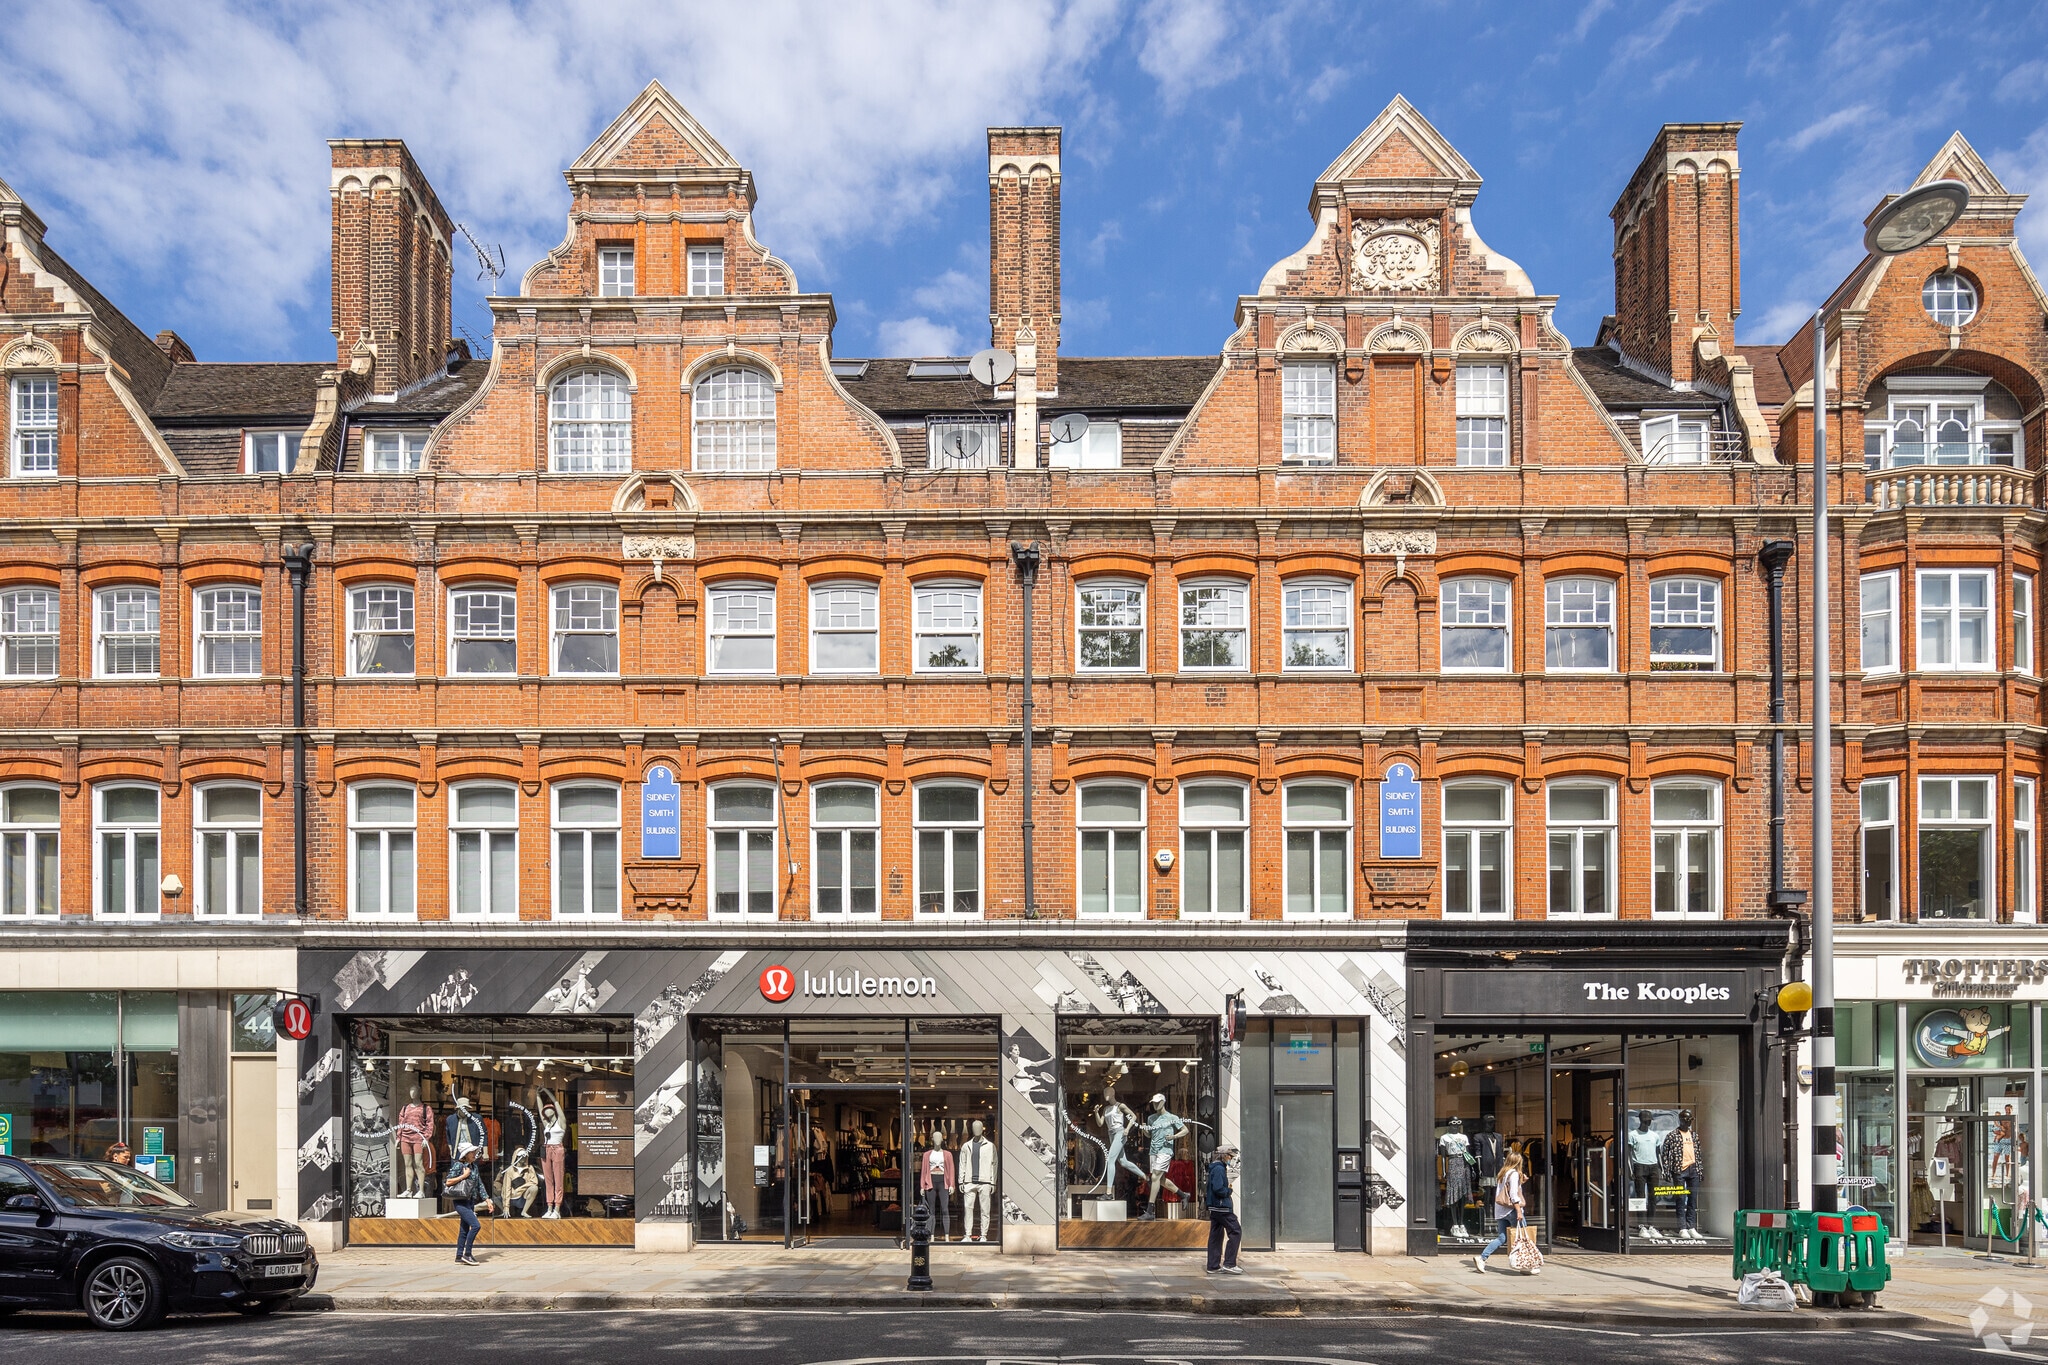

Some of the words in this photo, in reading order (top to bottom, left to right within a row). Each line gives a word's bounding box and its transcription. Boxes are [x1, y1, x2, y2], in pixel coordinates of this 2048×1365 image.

[646, 793, 676, 801] SIDNEY
[1385, 792, 1415, 800] SIDNEY
[648, 809, 674, 817] SMITH
[1388, 808, 1414, 816] SMITH
[646, 827, 676, 835] BUILDINGS
[1385, 826, 1416, 834] BUILDINGS
[804, 970, 936, 995] lululemon
[1937, 981, 2020, 991] Childrenswear
[1583, 982, 1630, 1000] The
[1636, 982, 1730, 1004] Kooples
[244, 1016, 274, 1033] 44
